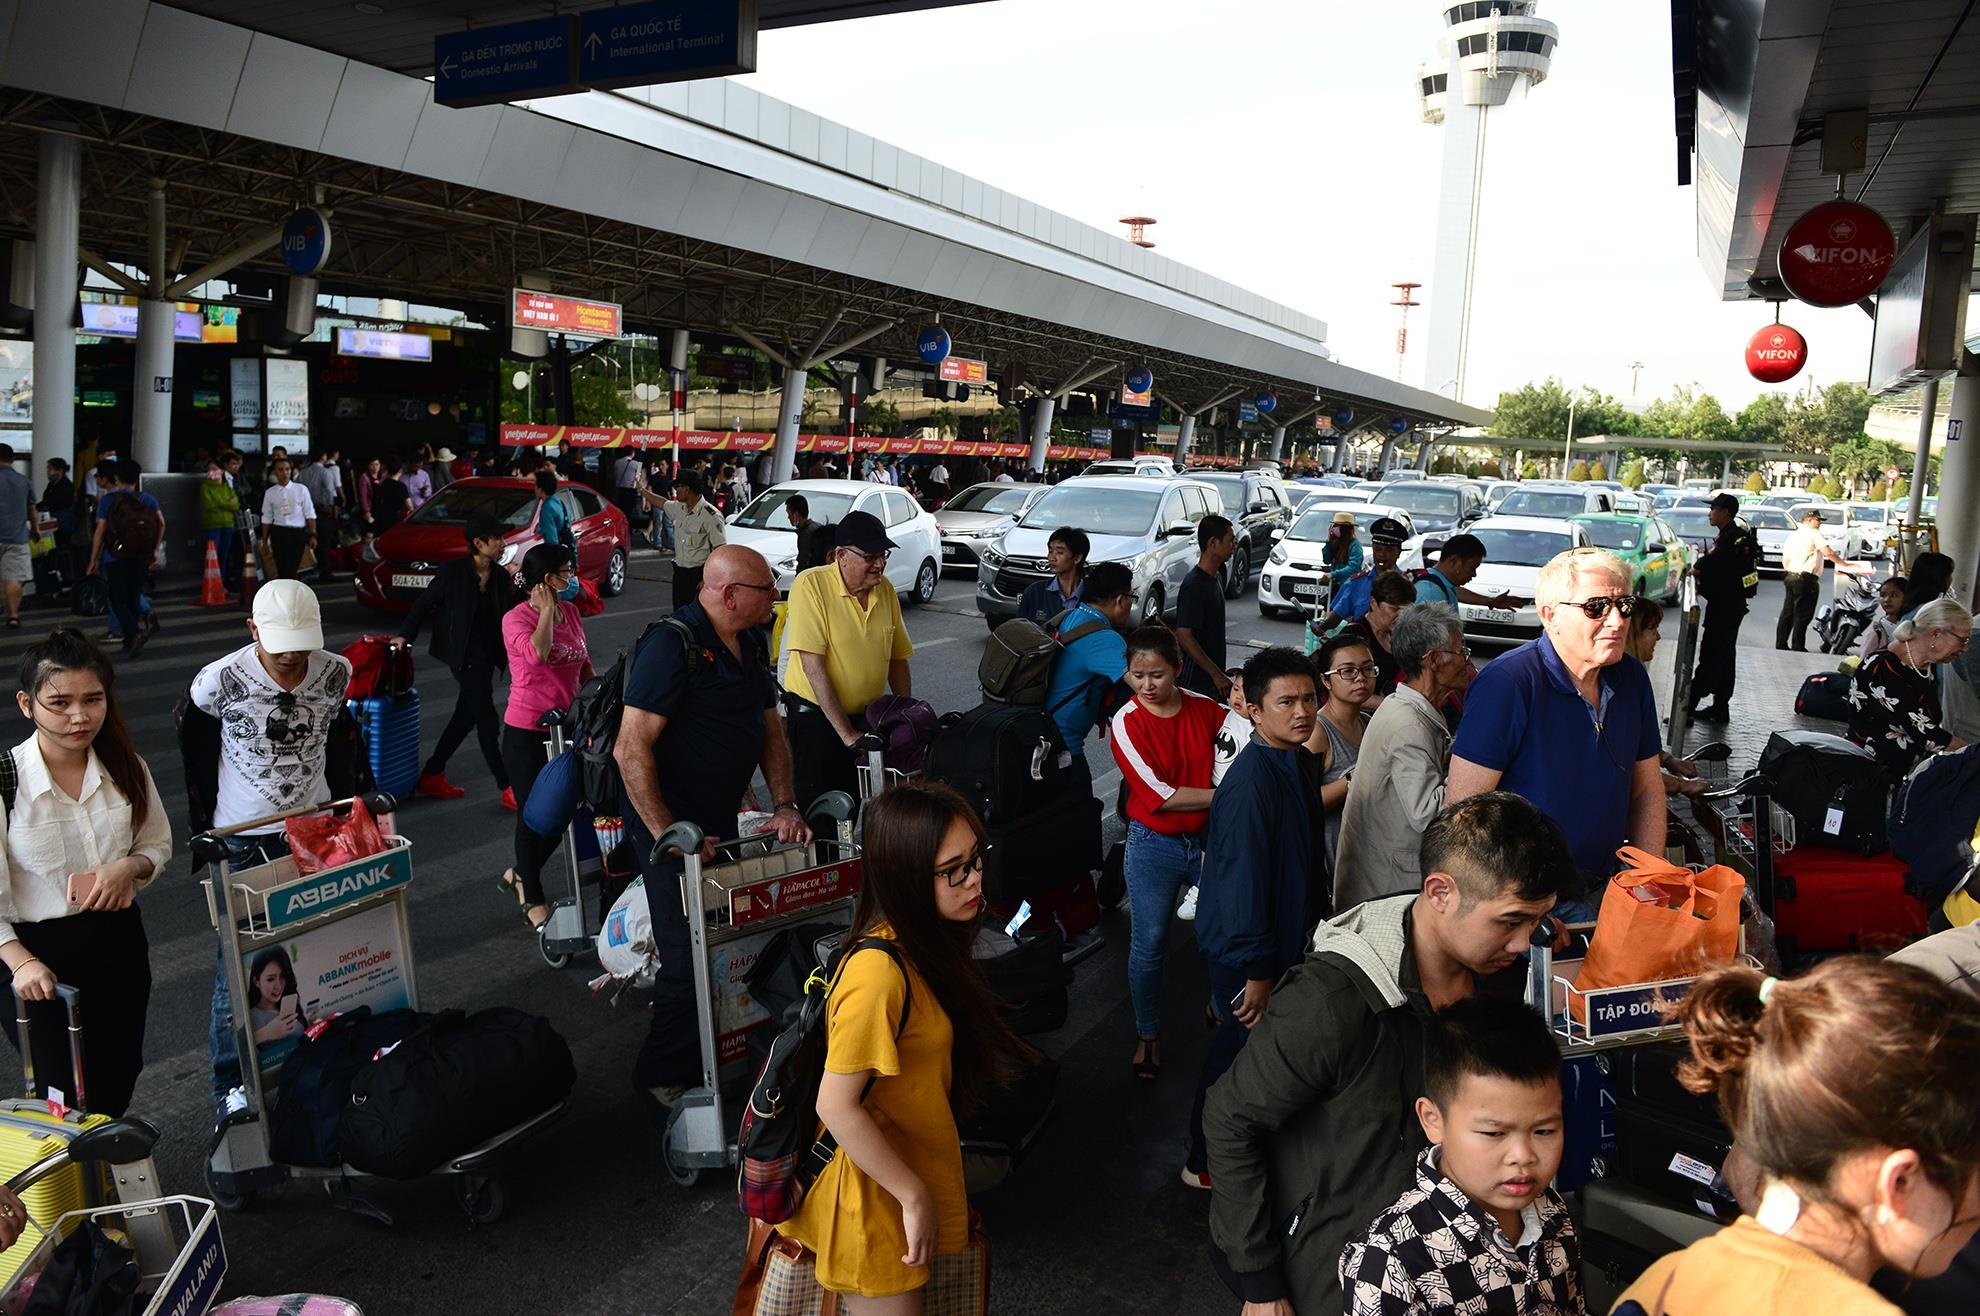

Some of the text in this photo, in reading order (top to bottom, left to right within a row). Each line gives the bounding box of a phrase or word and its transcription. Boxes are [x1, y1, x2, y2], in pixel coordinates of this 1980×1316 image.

[610, 27, 626, 39] GA
[630, 17, 664, 37] QUỐC
[461, 50, 475, 62] GA
[498, 41, 532, 56] TRONG
[609, 32, 724, 57] International Terminal
[461, 59, 538, 79] Domestic Arrivals
[284, 235, 306, 251] VIB
[920, 341, 937, 352] VIB
[1756, 349, 1798, 360] VIFON
[1128, 376, 1142, 384] VIB
[286, 862, 397, 915] ABBANK
[783, 877, 821, 895] HAPACOL
[338, 950, 358, 964] DỊCH
[730, 951, 760, 971] HAPA
[318, 950, 392, 986] ABBANKmobile
[1597, 1002, 1625, 1023] TẬP
